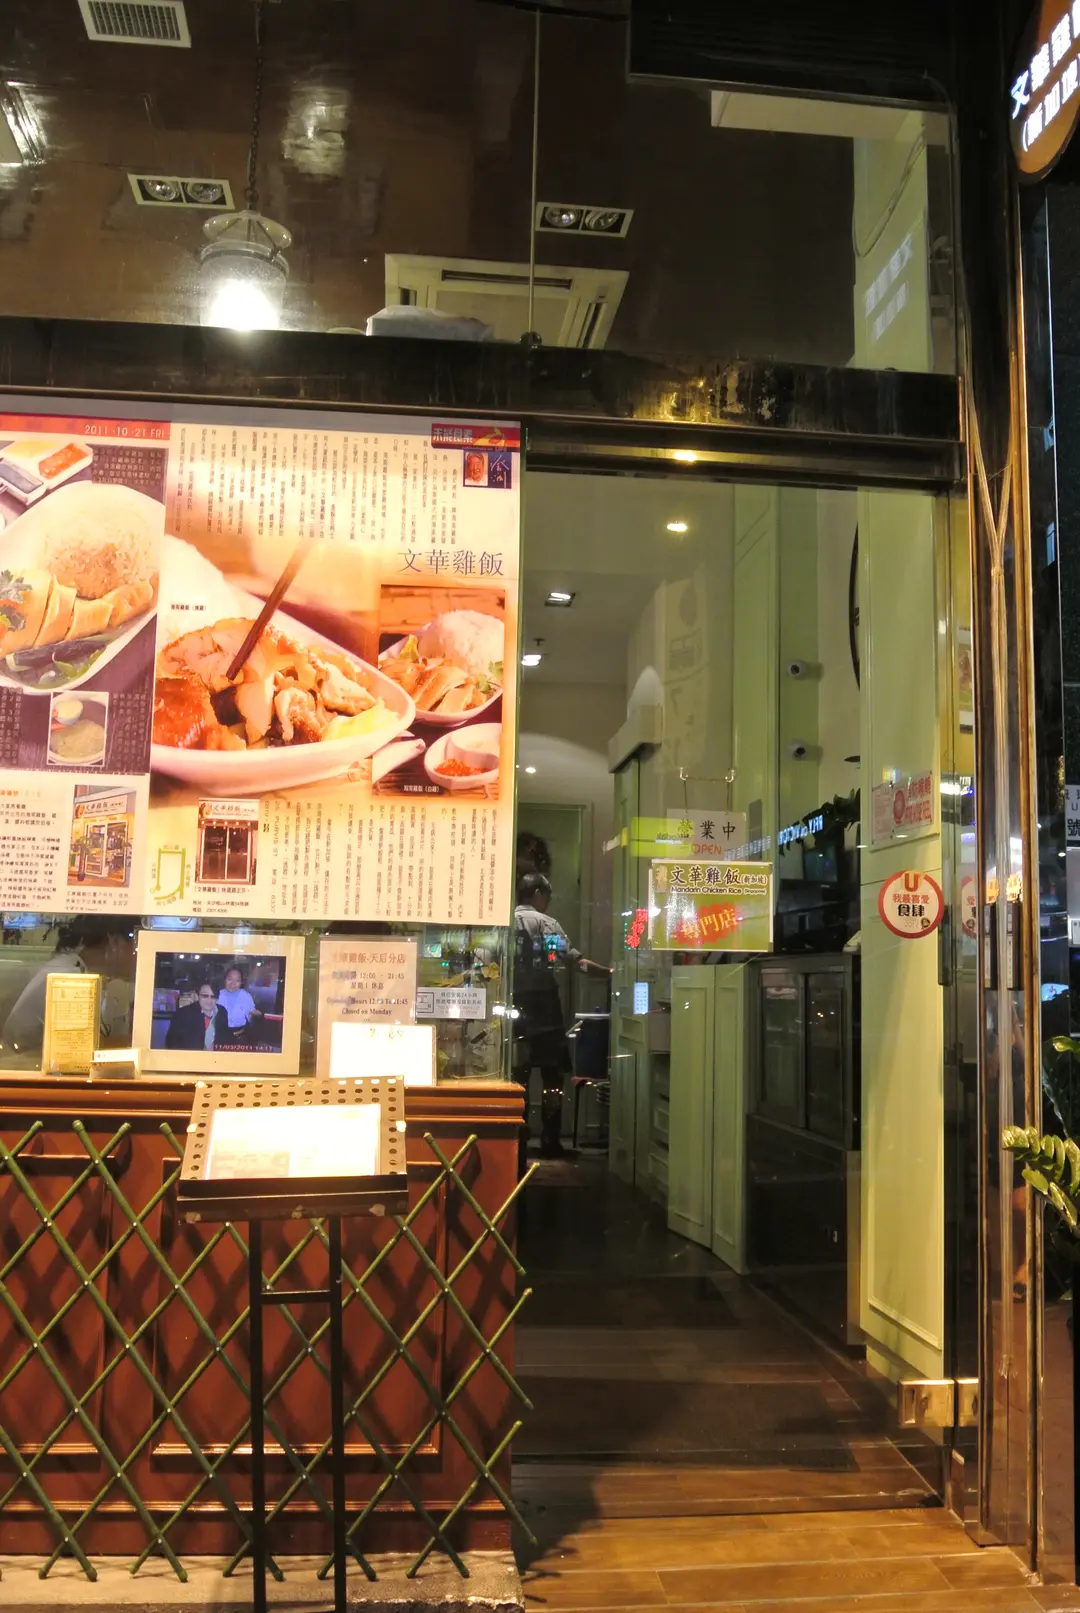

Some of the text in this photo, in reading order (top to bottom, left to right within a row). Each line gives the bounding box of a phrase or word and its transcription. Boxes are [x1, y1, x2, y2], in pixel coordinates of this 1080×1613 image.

[84, 424, 108, 435] 2011
[150, 428, 165, 439] FRI
[397, 548, 505, 577] 文華雞飯
[677, 818, 737, 841] 營業中
[691, 843, 722, 856] OPEN
[670, 866, 741, 886] 文華雞飯
[904, 872, 919, 892] U
[671, 886, 701, 894] Mandarin
[702, 886, 727, 894] Chicken
[728, 886, 742, 894] Rice
[892, 893, 930, 904] 我最喜愛
[897, 903, 925, 917] 食肆
[681, 908, 738, 939] 專門店
[359, 972, 376, 980] 12:00
[387, 972, 405, 980] 21:45
[341, 1007, 360, 1015] Closed
[369, 1008, 393, 1017] Monday
